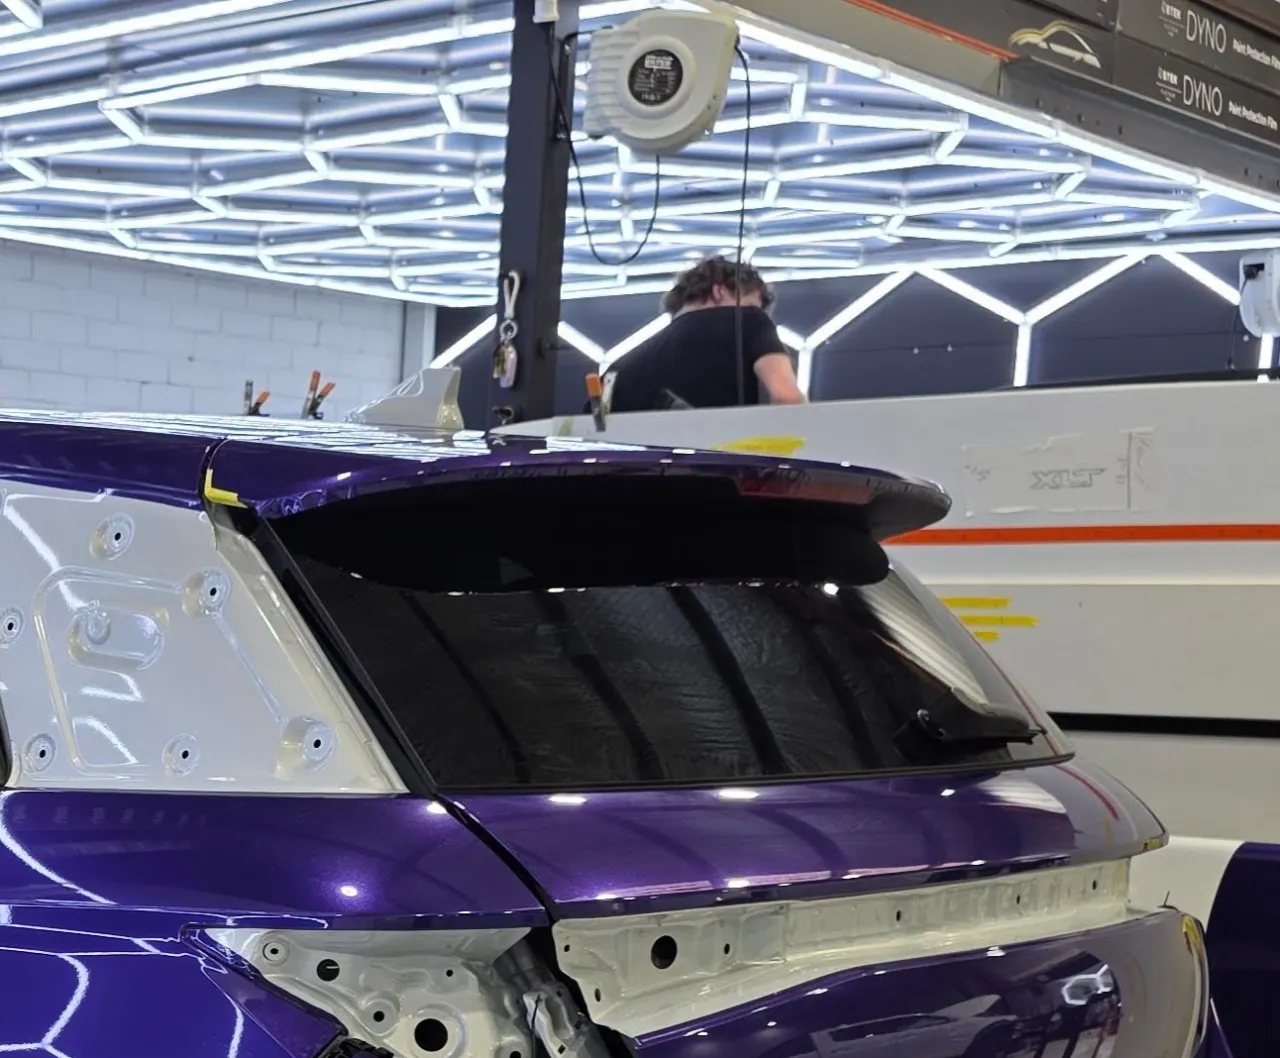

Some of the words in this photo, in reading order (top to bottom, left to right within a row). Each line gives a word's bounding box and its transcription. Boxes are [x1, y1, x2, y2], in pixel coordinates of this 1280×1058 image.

[1186, 9, 1227, 54] DYNO
[1183, 74, 1223, 116] DYNO
[1267, 115, 1278, 131] Film
